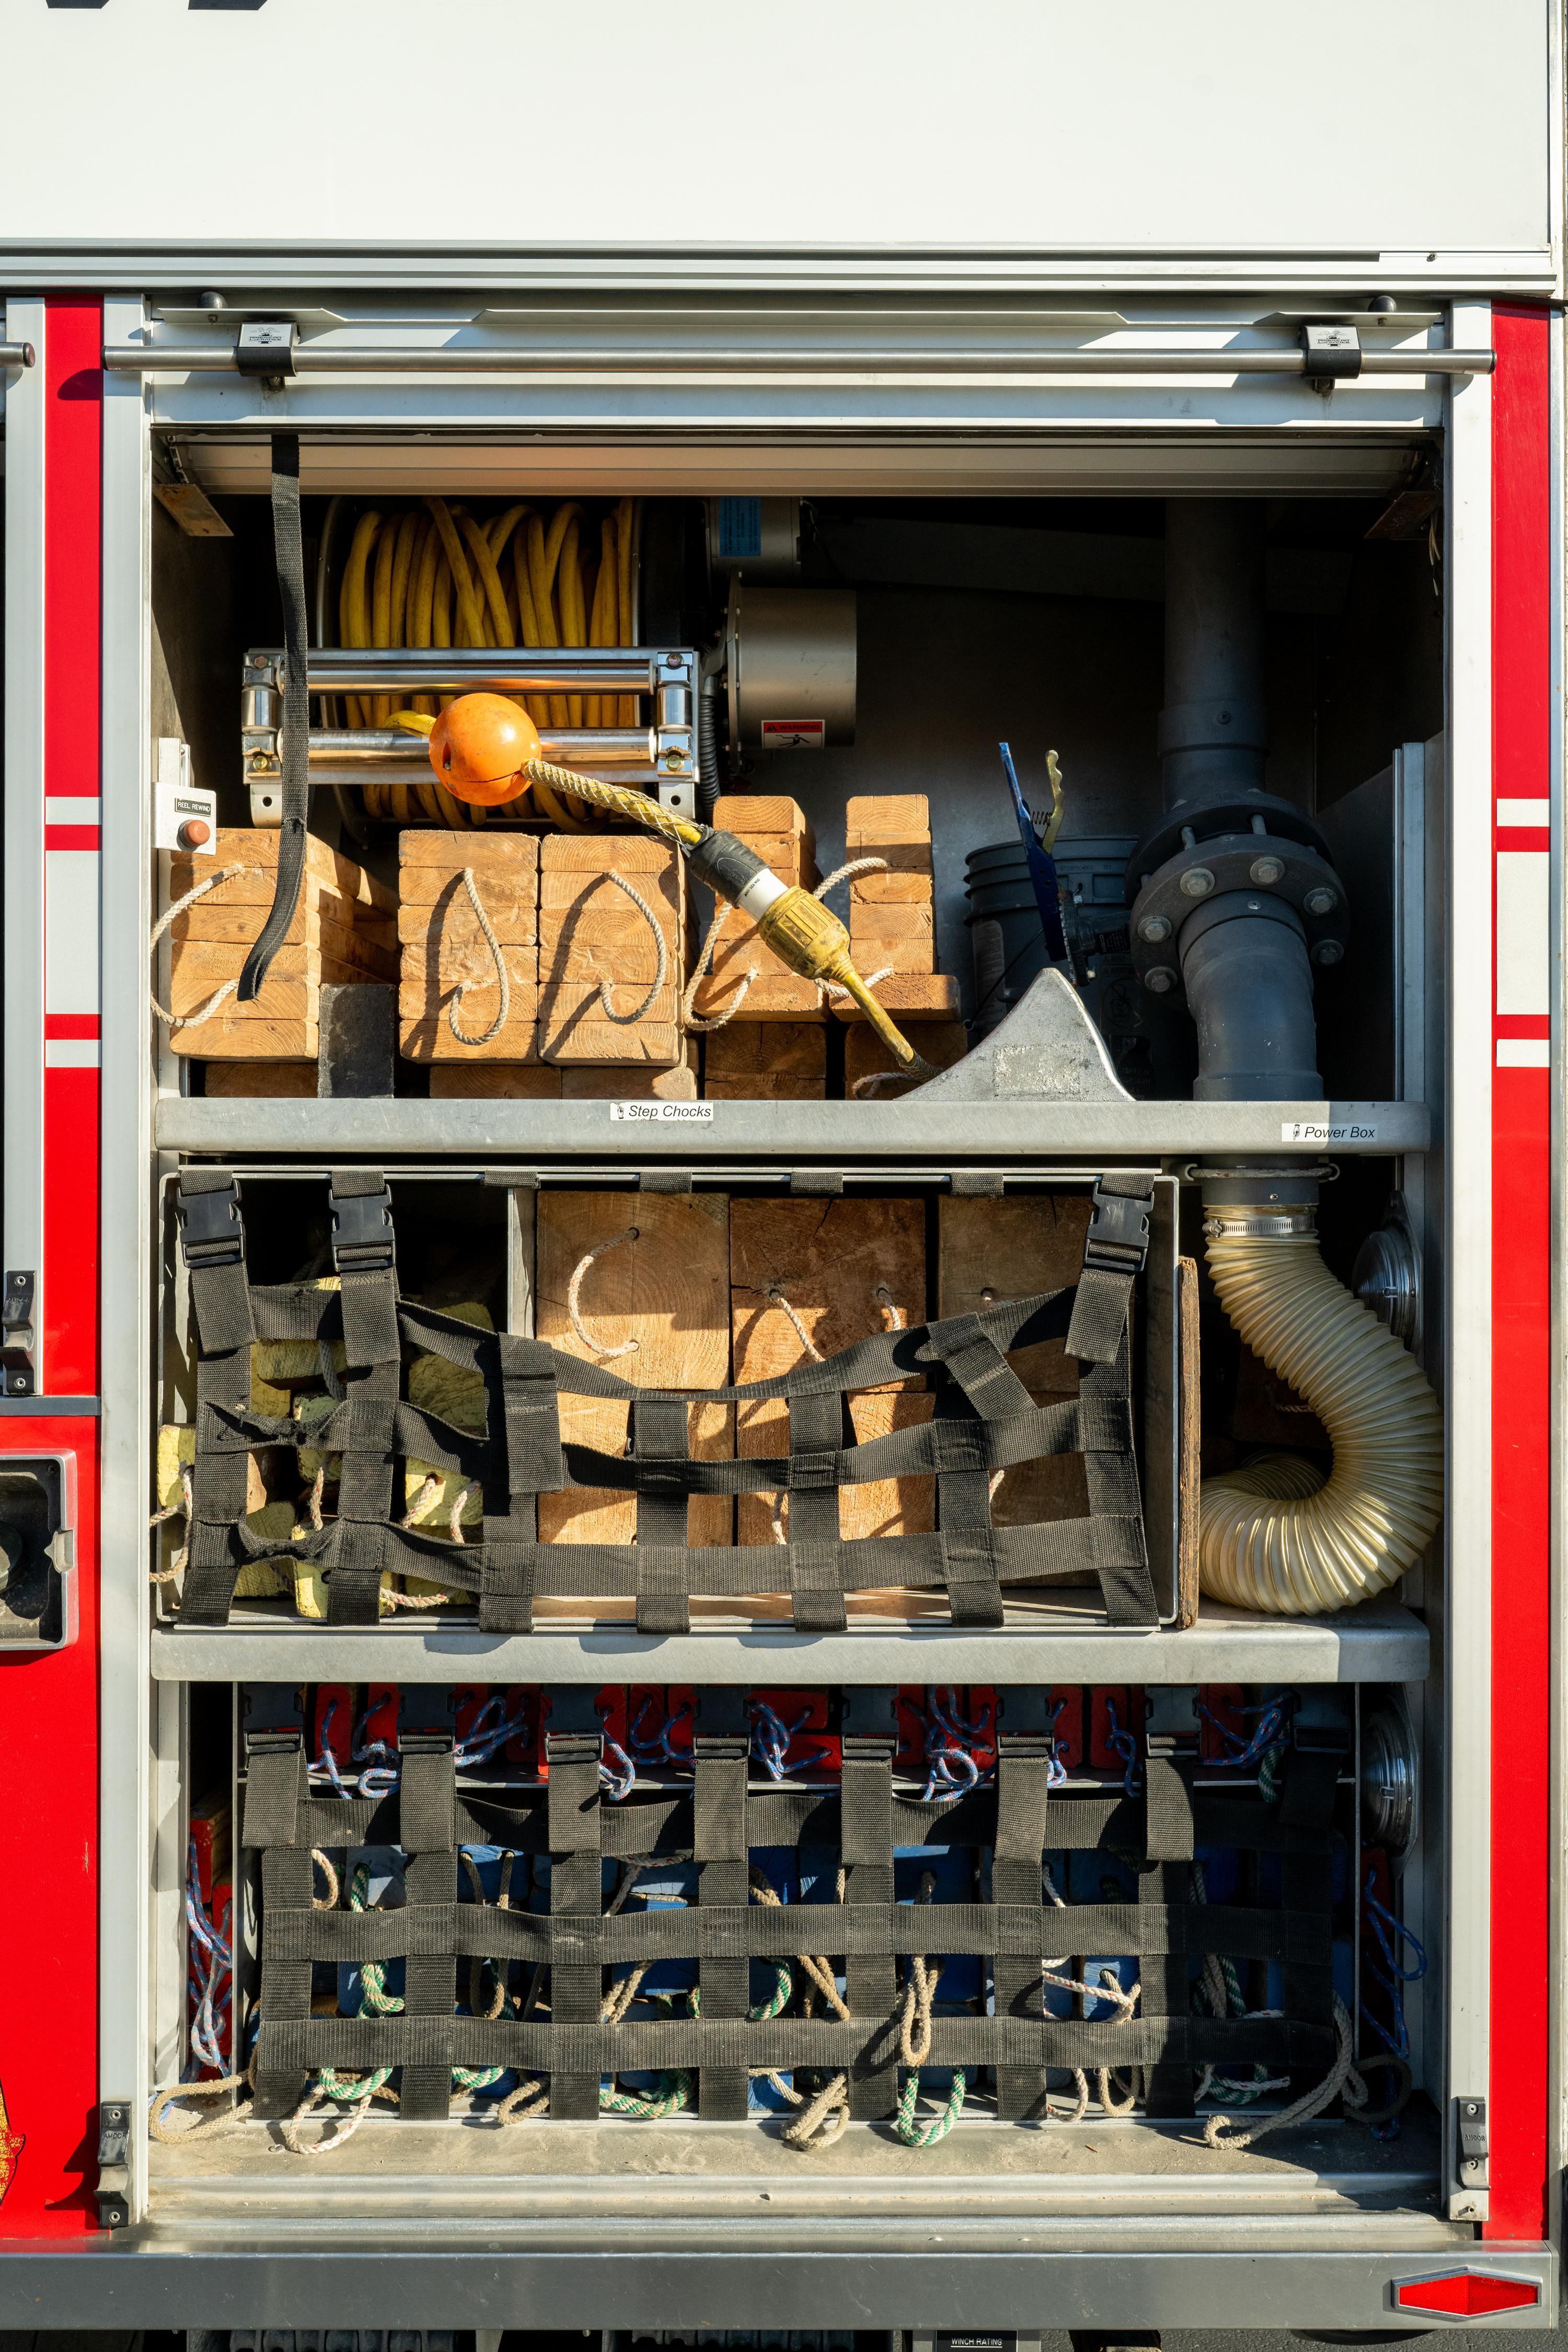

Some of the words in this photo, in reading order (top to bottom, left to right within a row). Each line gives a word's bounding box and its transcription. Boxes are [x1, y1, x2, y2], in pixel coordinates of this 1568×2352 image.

[192, 803, 210, 812] REWIND
[629, 1105, 658, 1119] Step
[663, 1105, 711, 1117] Chocks
[1305, 1126, 1347, 1138] Power
[1350, 1126, 1375, 1138] Box
